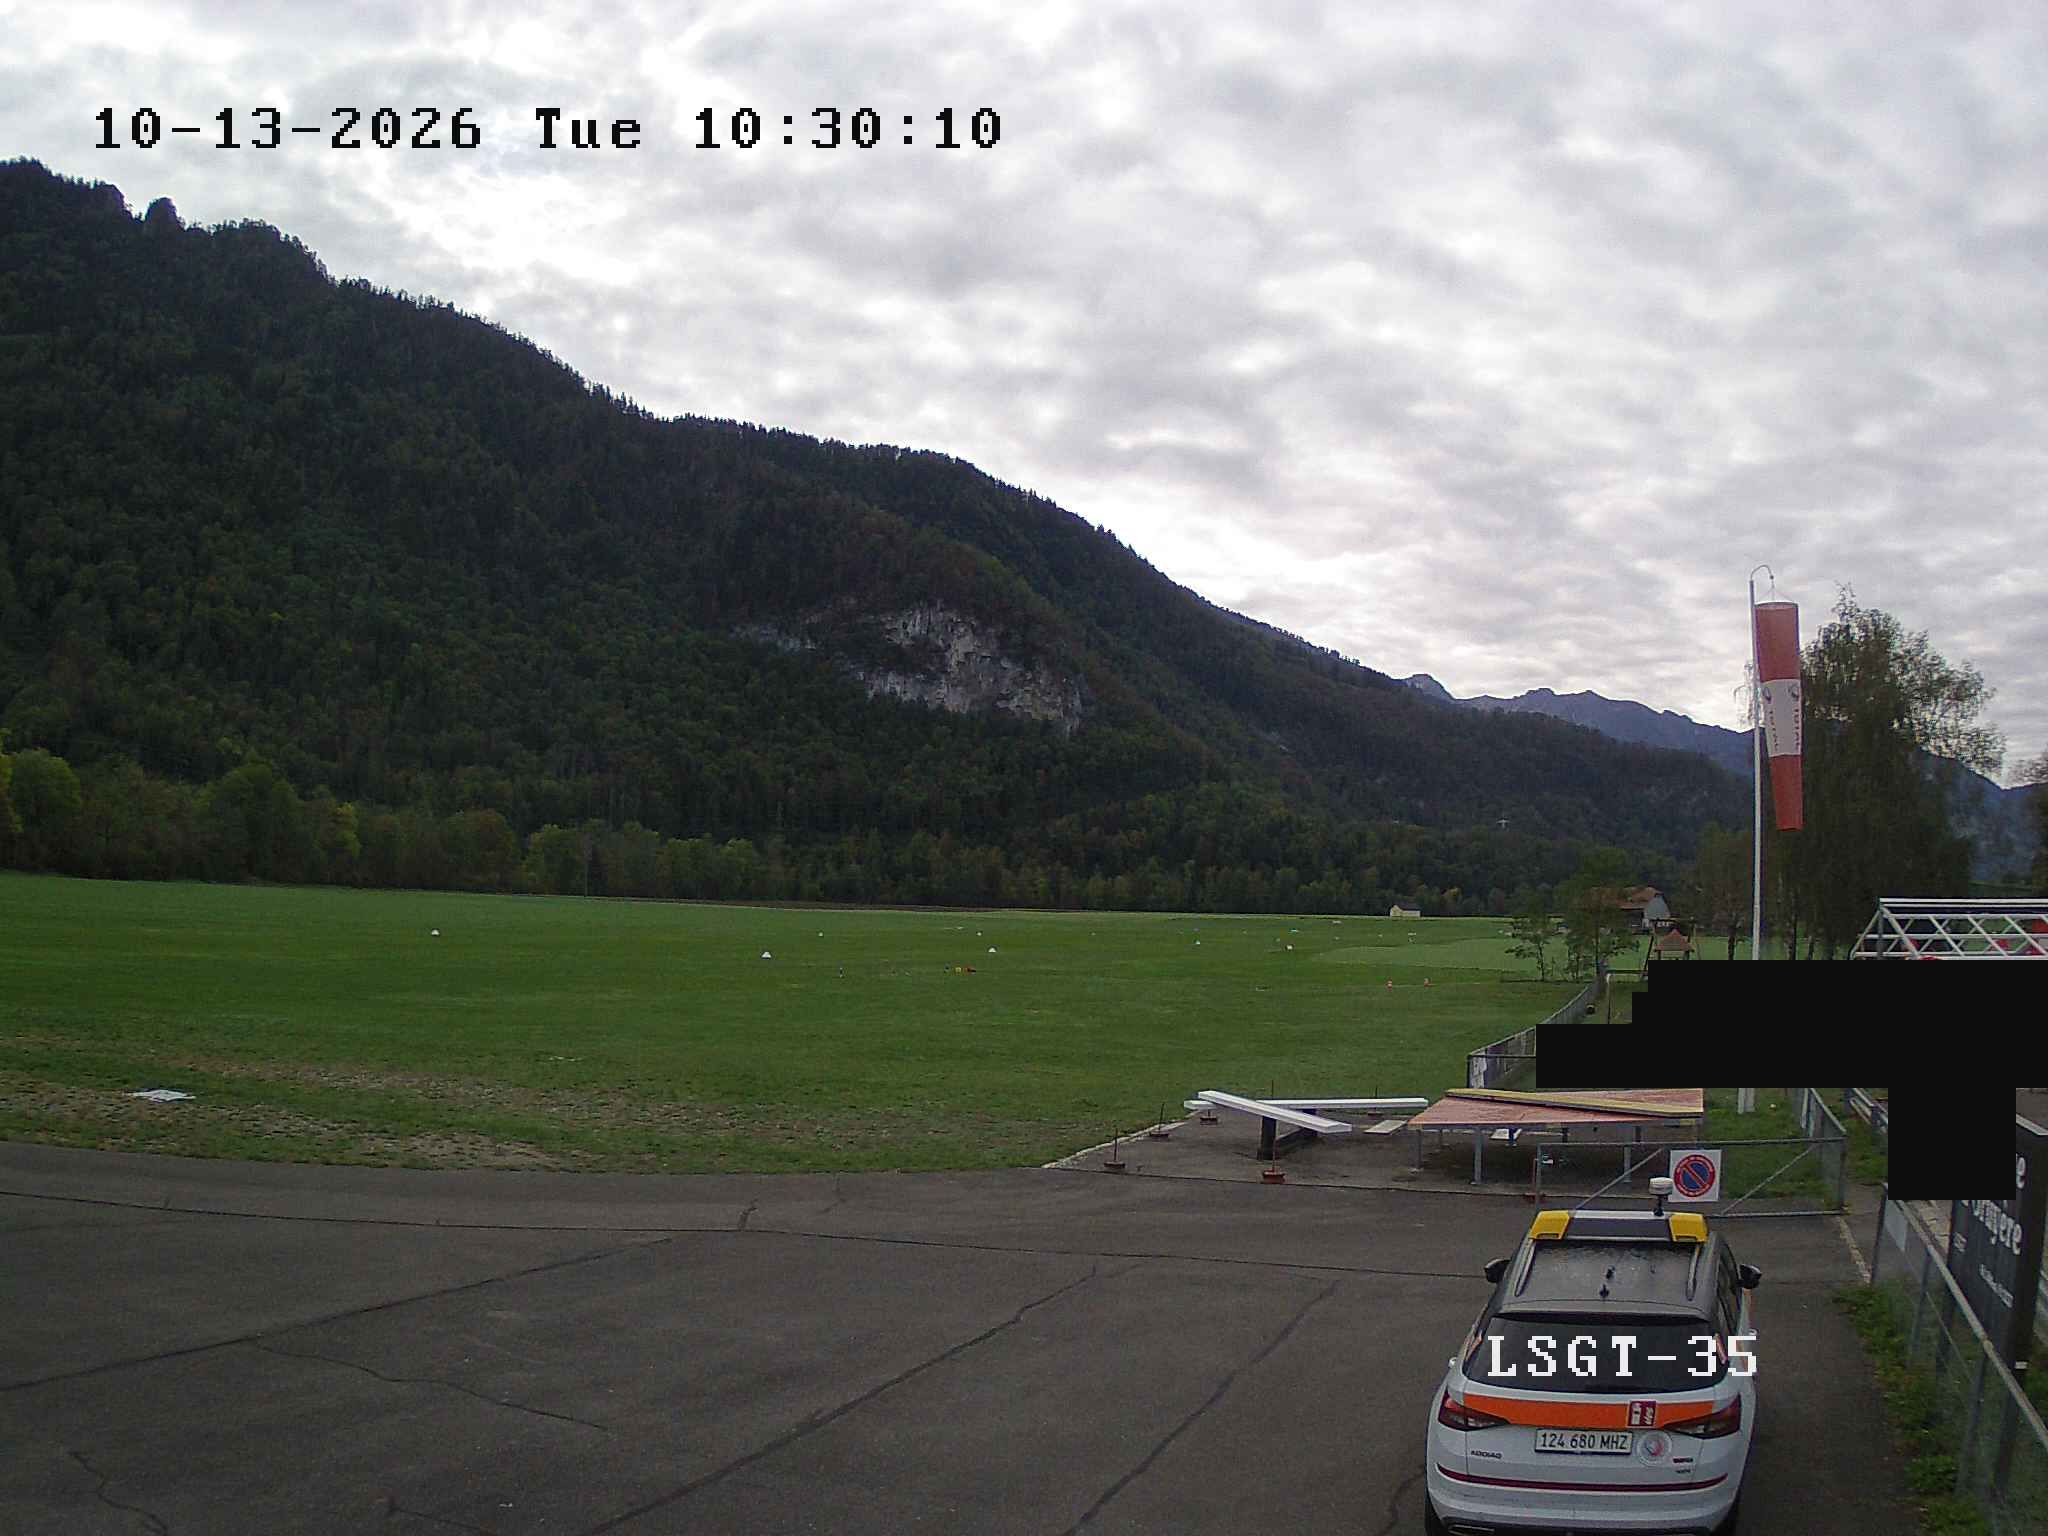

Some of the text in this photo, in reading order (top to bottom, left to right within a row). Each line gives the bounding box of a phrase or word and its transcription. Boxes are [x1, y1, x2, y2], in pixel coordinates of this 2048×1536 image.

[1541, 1432, 1628, 1450] 124 680 MHZ
